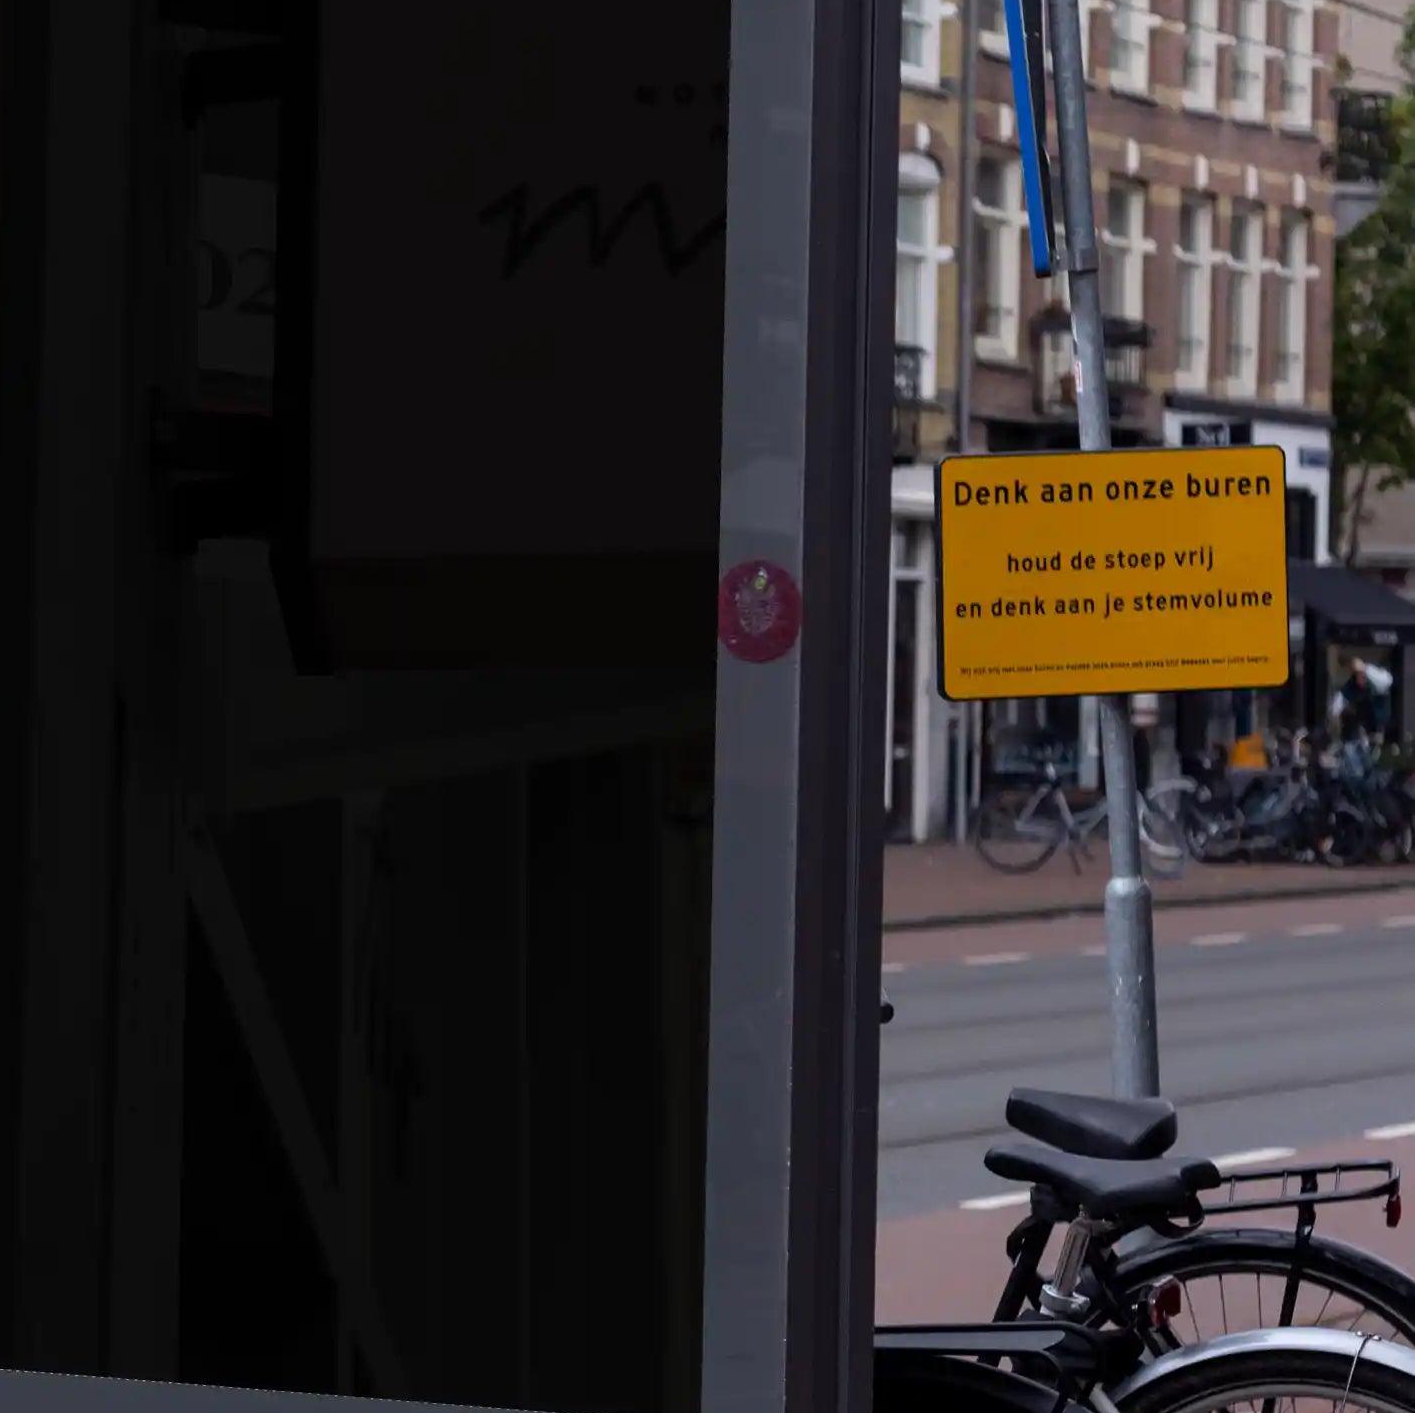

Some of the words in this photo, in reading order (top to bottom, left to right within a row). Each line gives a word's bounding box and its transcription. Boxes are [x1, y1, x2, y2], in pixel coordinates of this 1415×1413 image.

[954, 479, 1029, 507] Denk
[1040, 483, 1093, 504] aan
[1105, 477, 1175, 501] onze
[1186, 472, 1271, 499] buren
[1007, 551, 1062, 574] houd
[1070, 549, 1096, 570] de
[1104, 548, 1166, 571] stoep
[1174, 545, 1215, 572] vrij
[955, 600, 982, 619] en
[990, 595, 1046, 618] denk
[1054, 596, 1095, 616] aan
[1103, 592, 1126, 620] je
[1132, 587, 1273, 613] stemvolume
